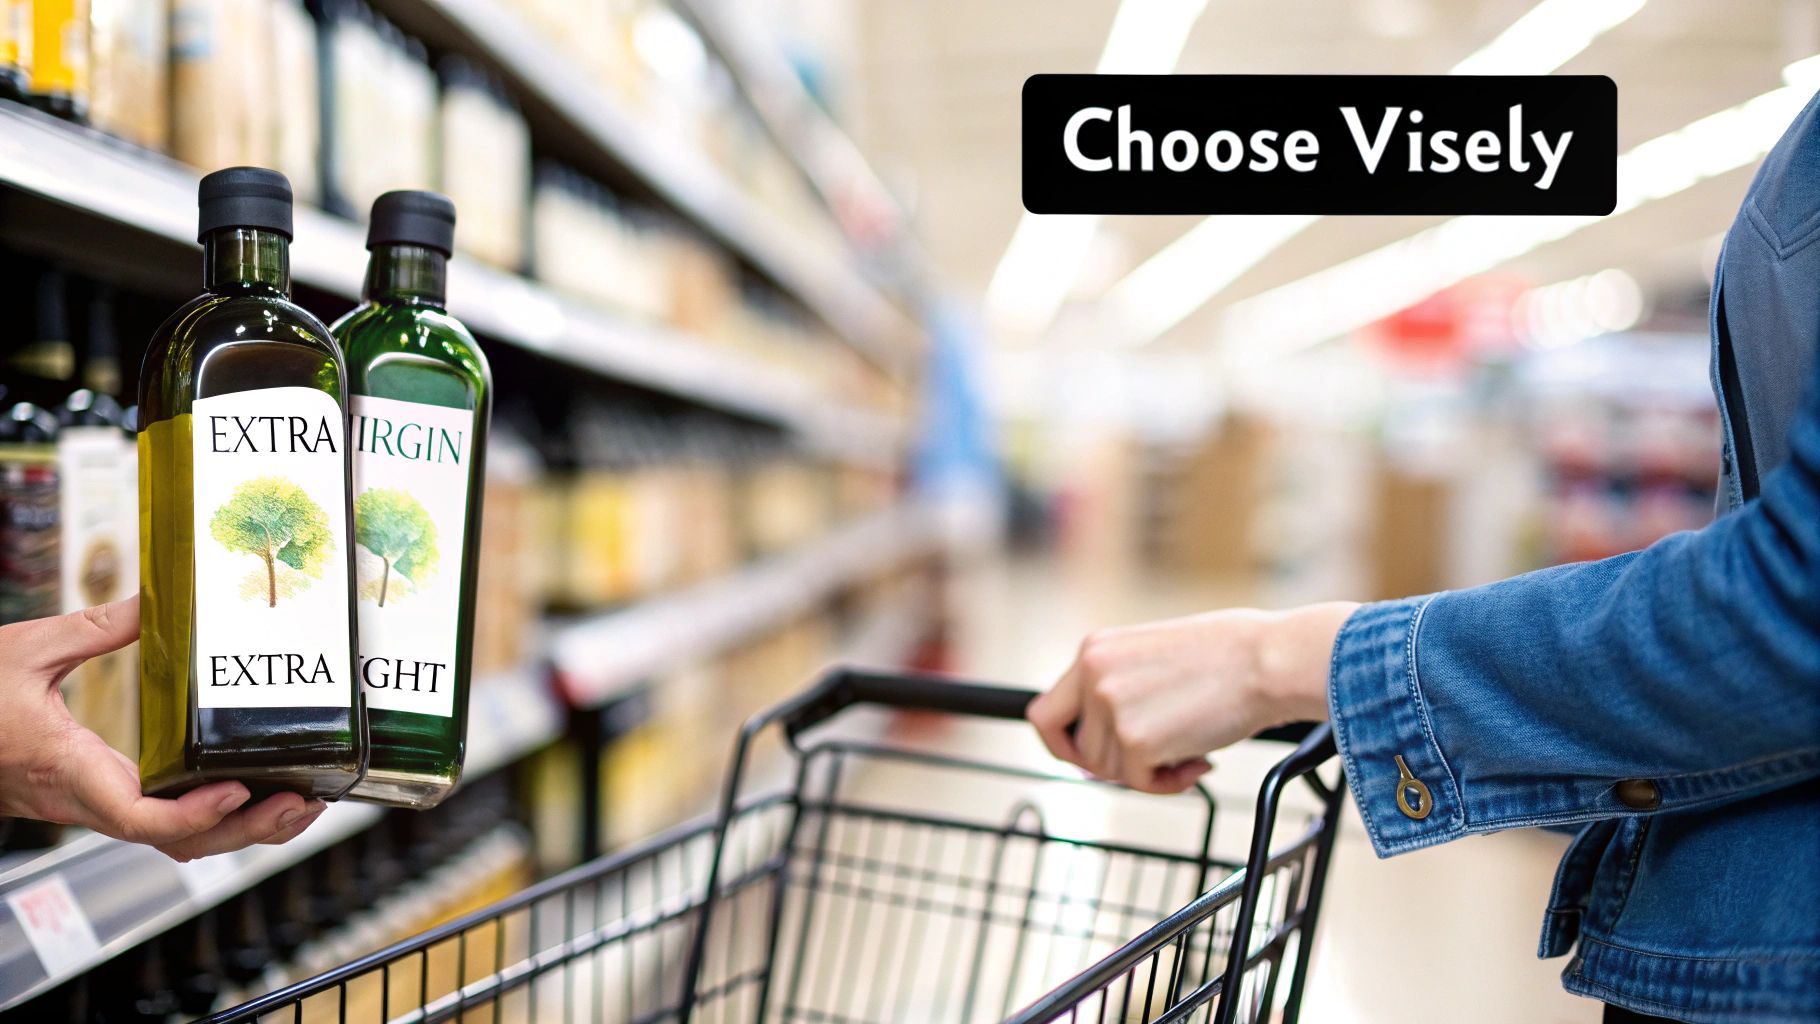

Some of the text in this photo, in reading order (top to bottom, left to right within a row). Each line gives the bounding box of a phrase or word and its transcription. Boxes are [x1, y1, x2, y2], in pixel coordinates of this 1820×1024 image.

[209, 415, 337, 454] EXTRA
[357, 415, 463, 465] IRGIN
[209, 653, 336, 687] EXTRA
[359, 655, 446, 693] GHT
